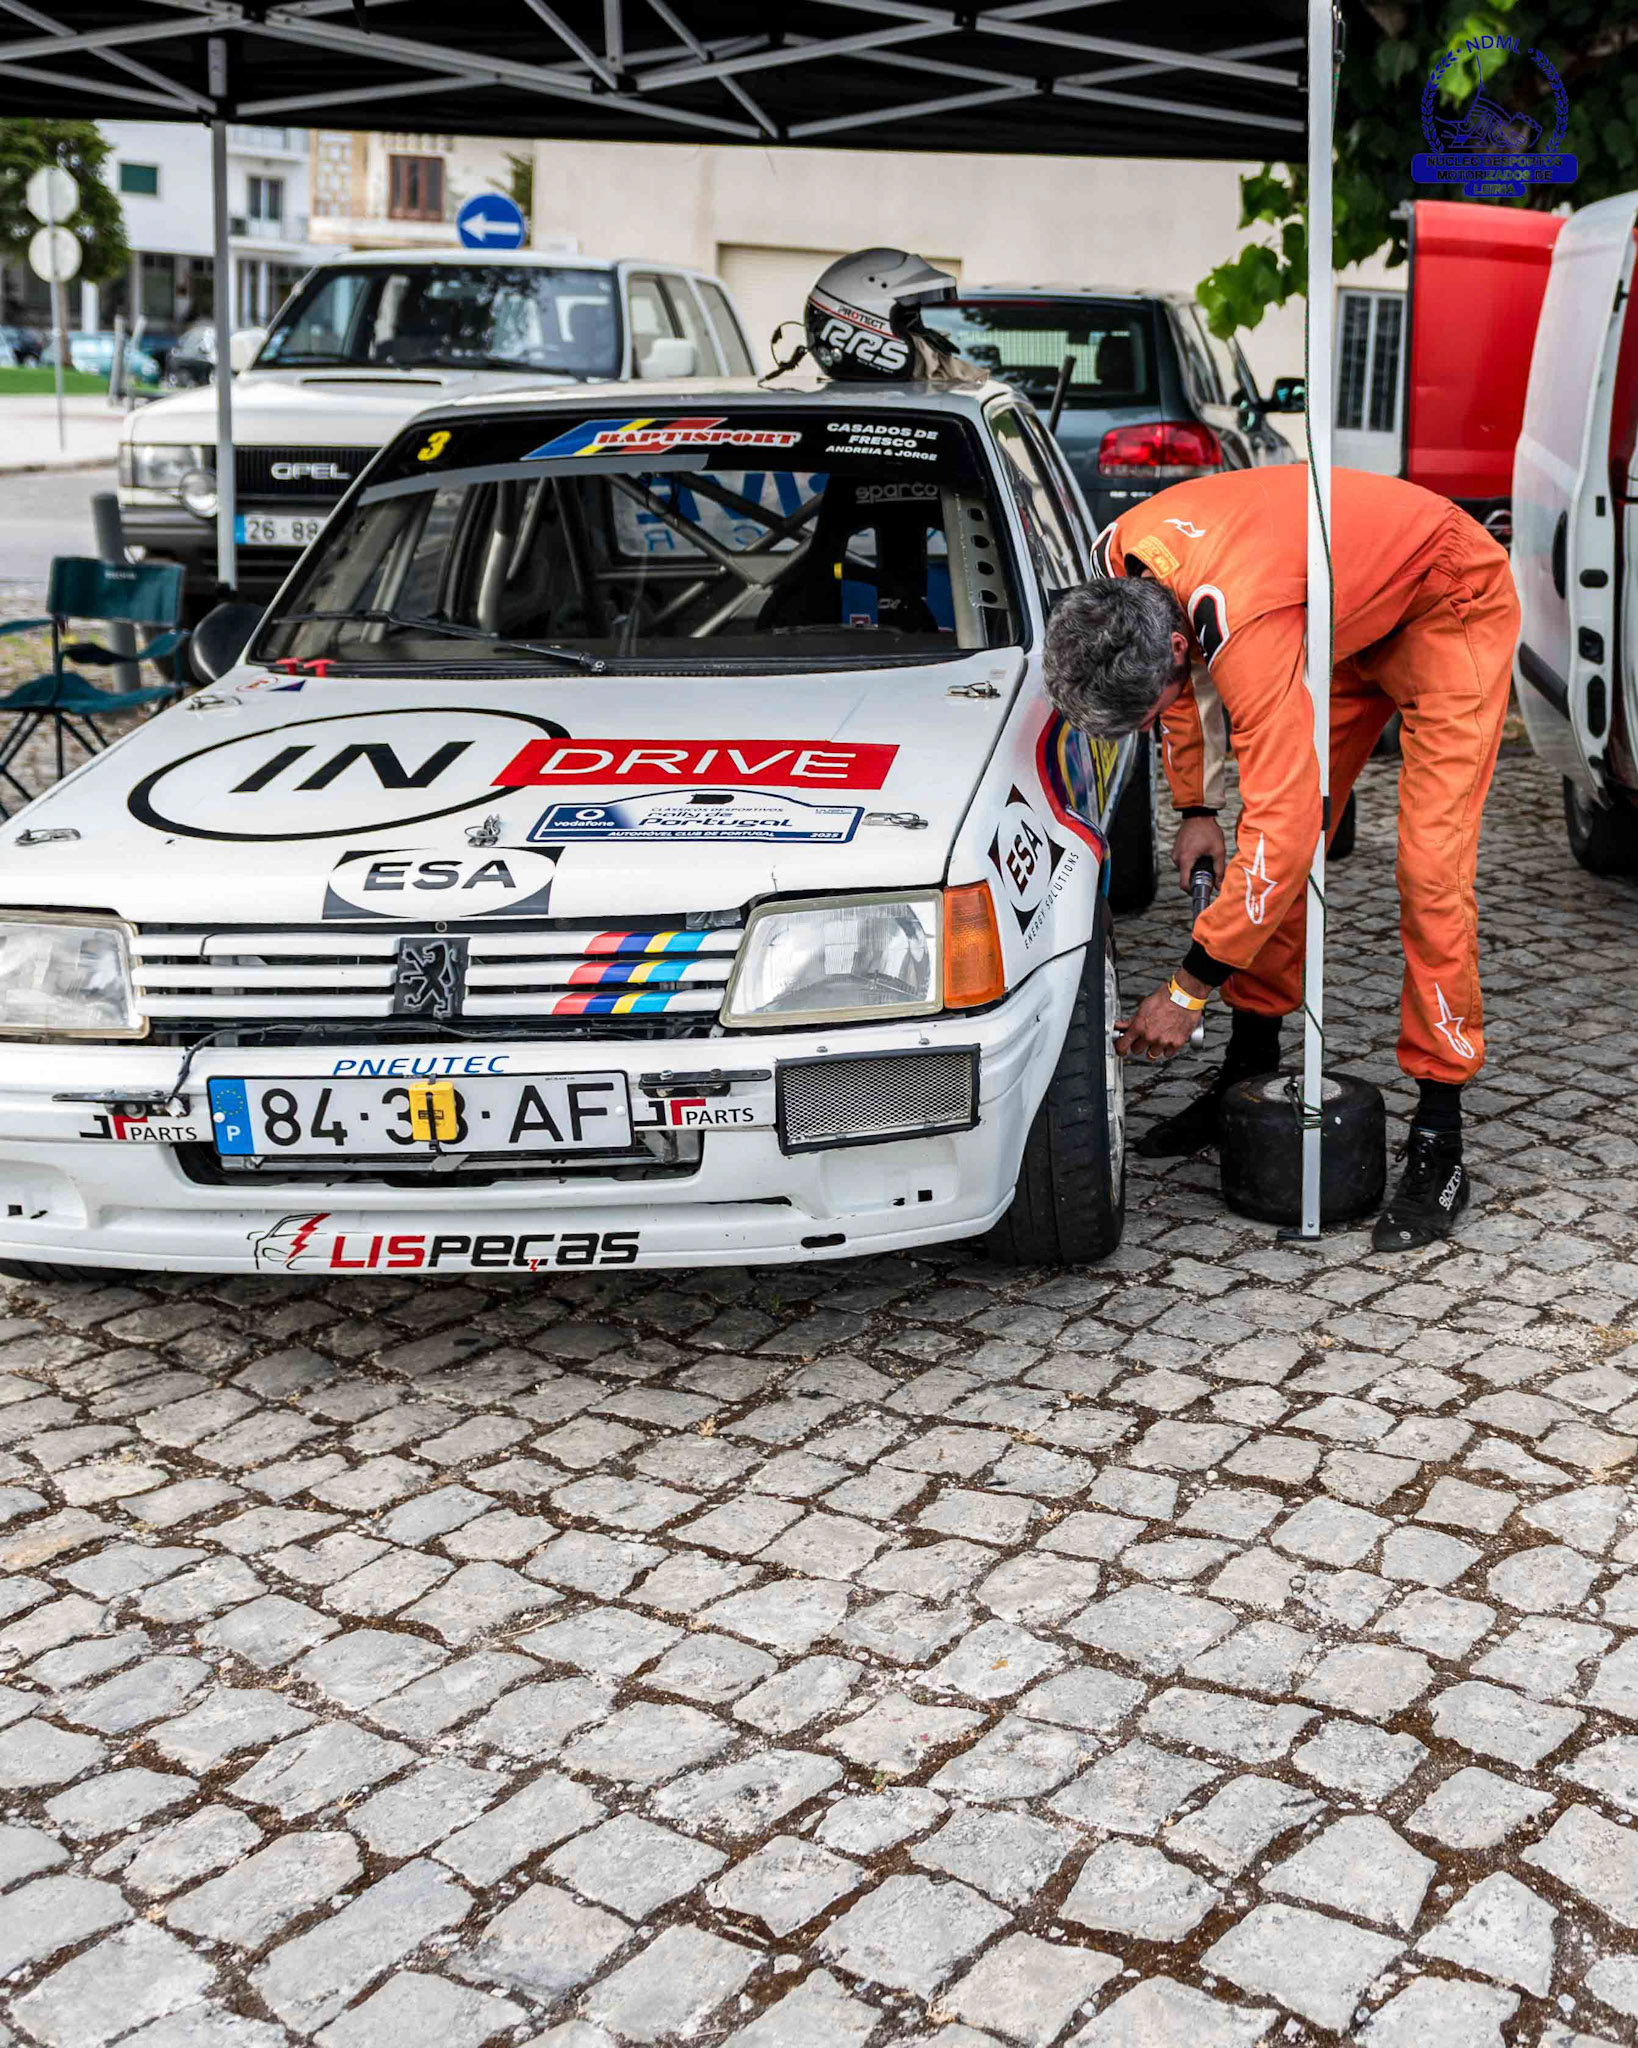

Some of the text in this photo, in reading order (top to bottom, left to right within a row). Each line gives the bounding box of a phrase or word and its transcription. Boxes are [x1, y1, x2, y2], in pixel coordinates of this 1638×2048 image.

[838, 305, 885, 329] PROTECT
[820, 318, 909, 370] RRS
[597, 431, 800, 447] BAPTISPORT
[827, 423, 938, 440] CASADOS DE
[417, 431, 452, 461] 3
[848, 435, 917, 448] FRESCO
[825, 445, 881, 456] ANDREIA
[894, 450, 938, 461] JORGE
[271, 462, 351, 480] OPEL
[855, 482, 939, 501] sparco
[229, 741, 857, 792] IN DRIVE
[638, 818, 793, 828] Portugal
[647, 811, 701, 819] rally
[1006, 819, 1044, 896] ESA
[364, 860, 519, 890] ESA
[1024, 852, 1079, 950] ENERGY SOLUTIONS
[333, 1055, 510, 1076] PNEUTEC
[686, 1107, 754, 1125] PARTS
[130, 1126, 198, 1142] PARTS
[227, 1126, 241, 1142] P
[1438, 1165, 1462, 1211] sparco
